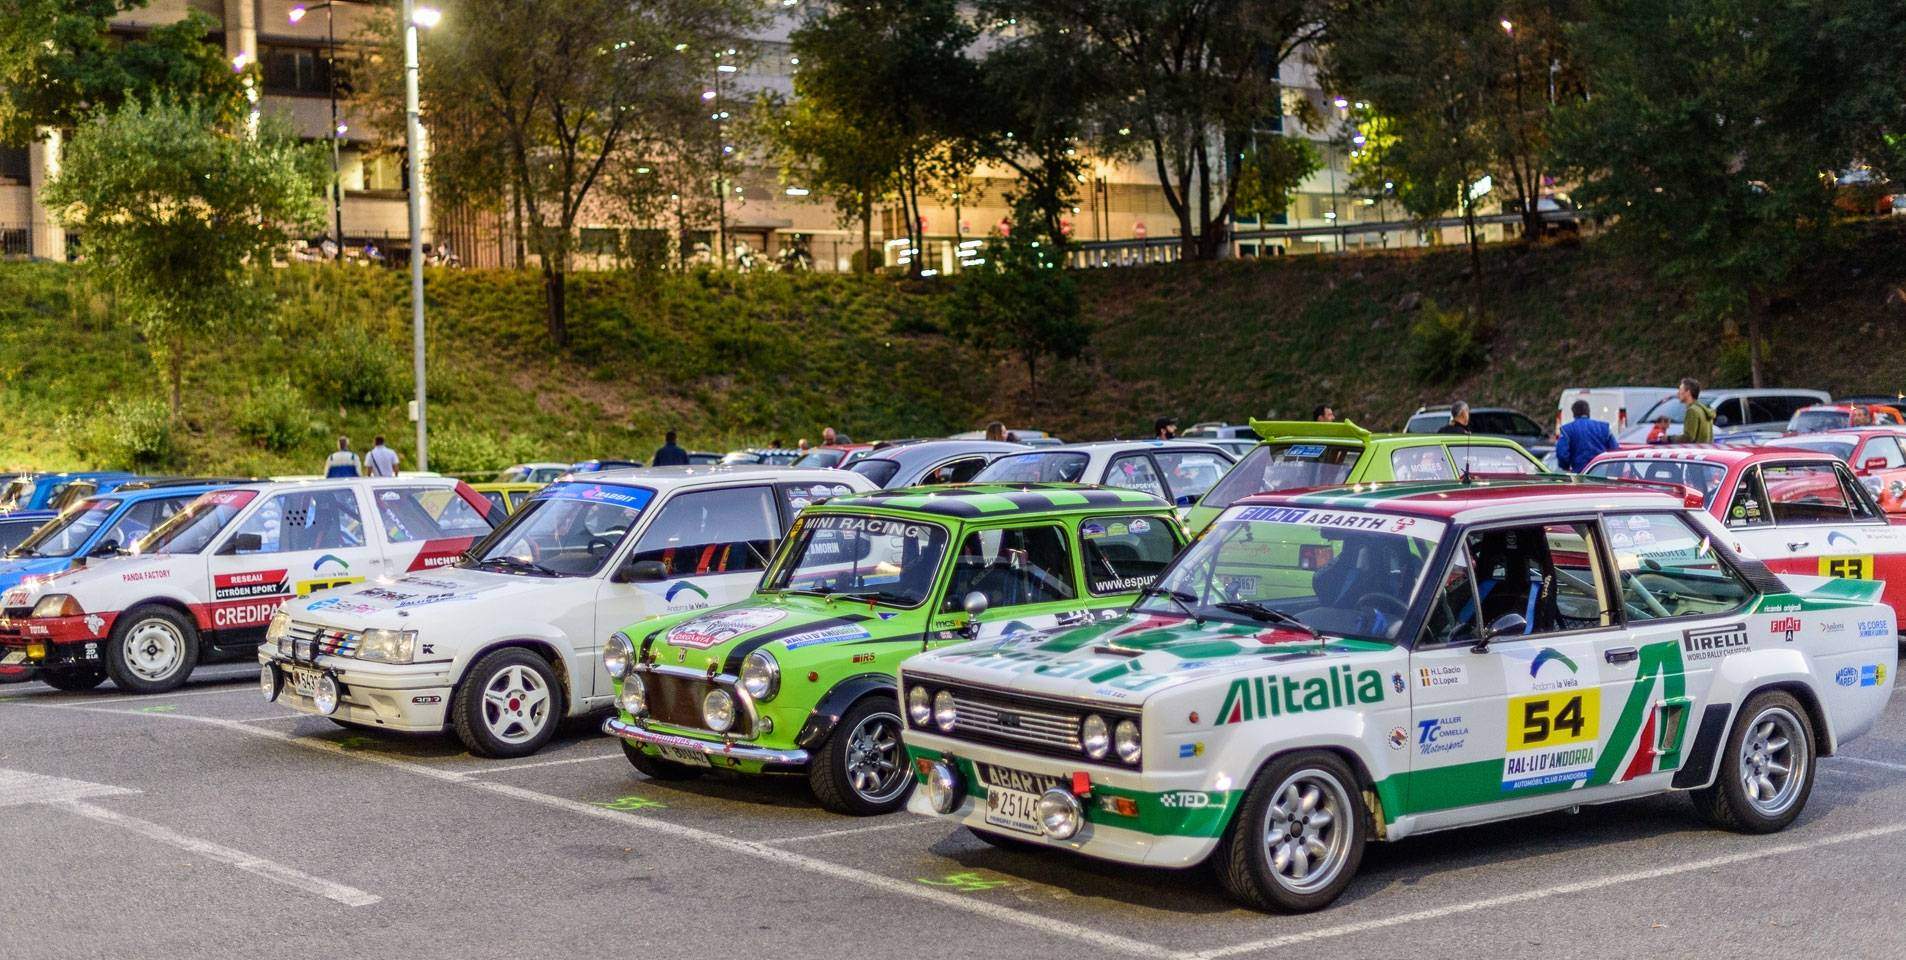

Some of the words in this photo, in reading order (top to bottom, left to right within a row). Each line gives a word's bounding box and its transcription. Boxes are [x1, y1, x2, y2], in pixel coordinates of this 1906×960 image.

[804, 518, 835, 529] MINI
[839, 518, 919, 538] RACING
[1236, 507, 1311, 523] FIAT
[1304, 513, 1388, 530] ABARTH
[122, 572, 143, 582] PANDA
[144, 570, 171, 580] FACTORY
[231, 574, 263, 584] RESEAU
[1830, 559, 1862, 579] 53
[252, 584, 277, 595] SPORT
[1682, 622, 1749, 652] PIRELLI
[1687, 653, 1707, 662] WORLD
[1707, 650, 1723, 660] RALLY
[1563, 679, 1578, 687] Vella
[1214, 664, 1385, 725] Alitalia
[1523, 696, 1585, 744] 54
[1539, 747, 1594, 770] D'ANDORRA
